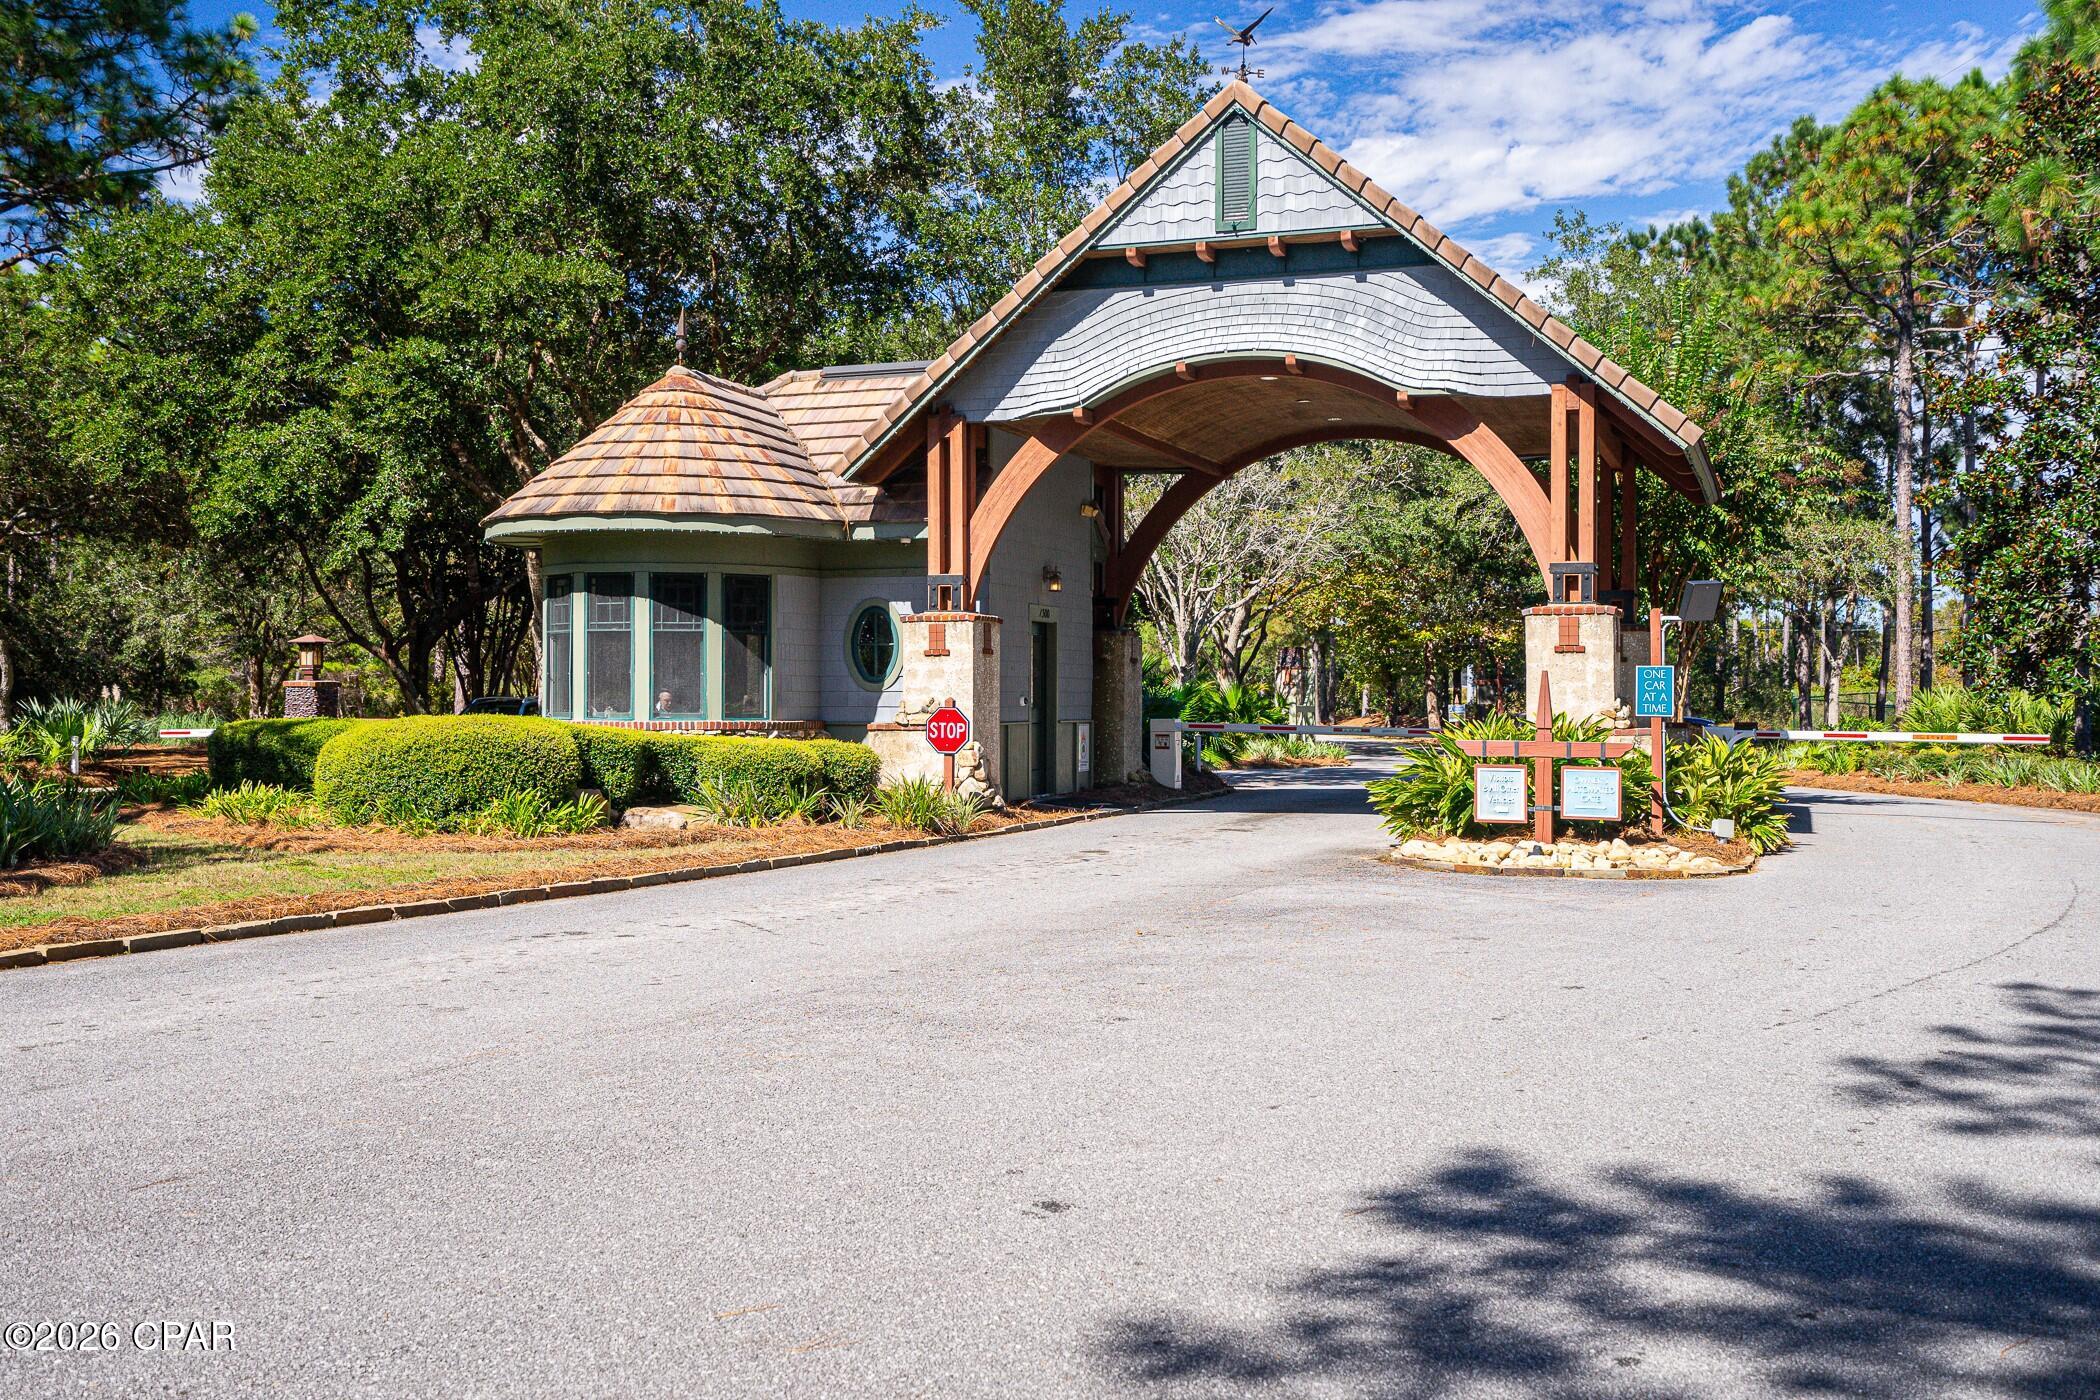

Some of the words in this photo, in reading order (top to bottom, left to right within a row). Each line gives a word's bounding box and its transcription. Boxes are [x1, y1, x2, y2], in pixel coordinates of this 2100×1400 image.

[1257, 69, 1265, 78] E
[1643, 669, 1667, 679] ONE
[1644, 681, 1666, 690] CAR
[1642, 692, 1656, 701] AT
[1659, 692, 1668, 701] A
[1642, 703, 1668, 713] TIME
[929, 722, 966, 738] STOP
[1567, 786, 1616, 795] AUTOMATED
[1581, 795, 1601, 804] GATE
